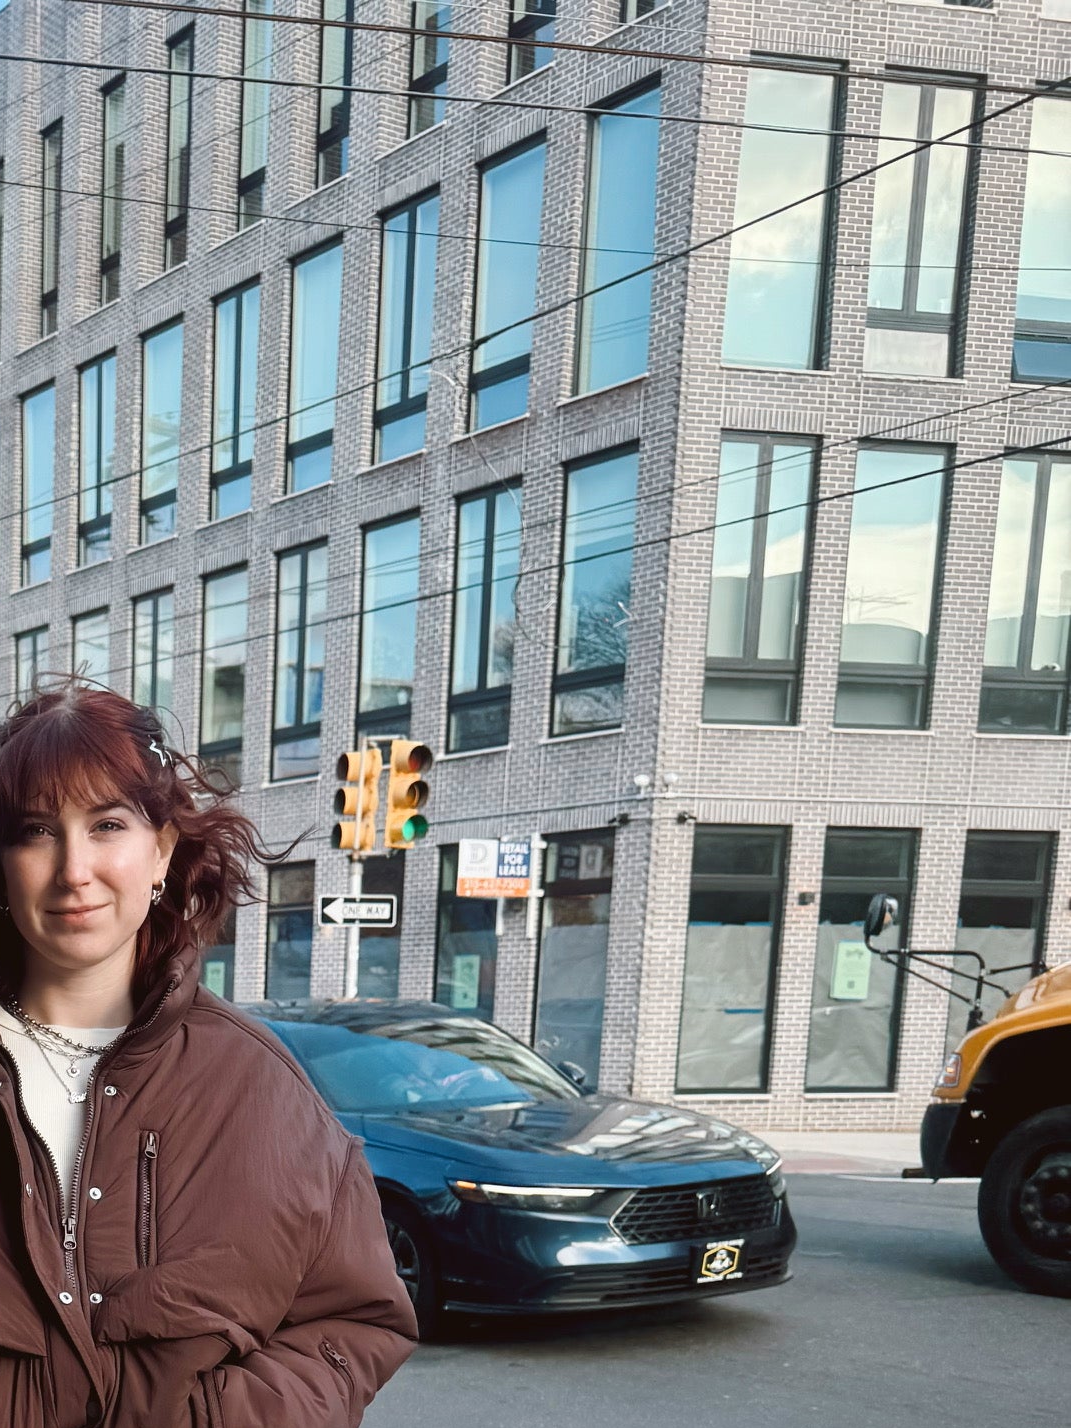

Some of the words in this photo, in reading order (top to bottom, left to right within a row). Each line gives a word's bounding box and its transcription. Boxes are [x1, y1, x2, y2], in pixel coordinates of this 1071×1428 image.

[499, 842, 529, 855] RETAIL
[503, 854, 524, 865] FOR
[498, 864, 528, 876] LEASE
[342, 905, 361, 917] ONE
[366, 905, 386, 917] WAY
